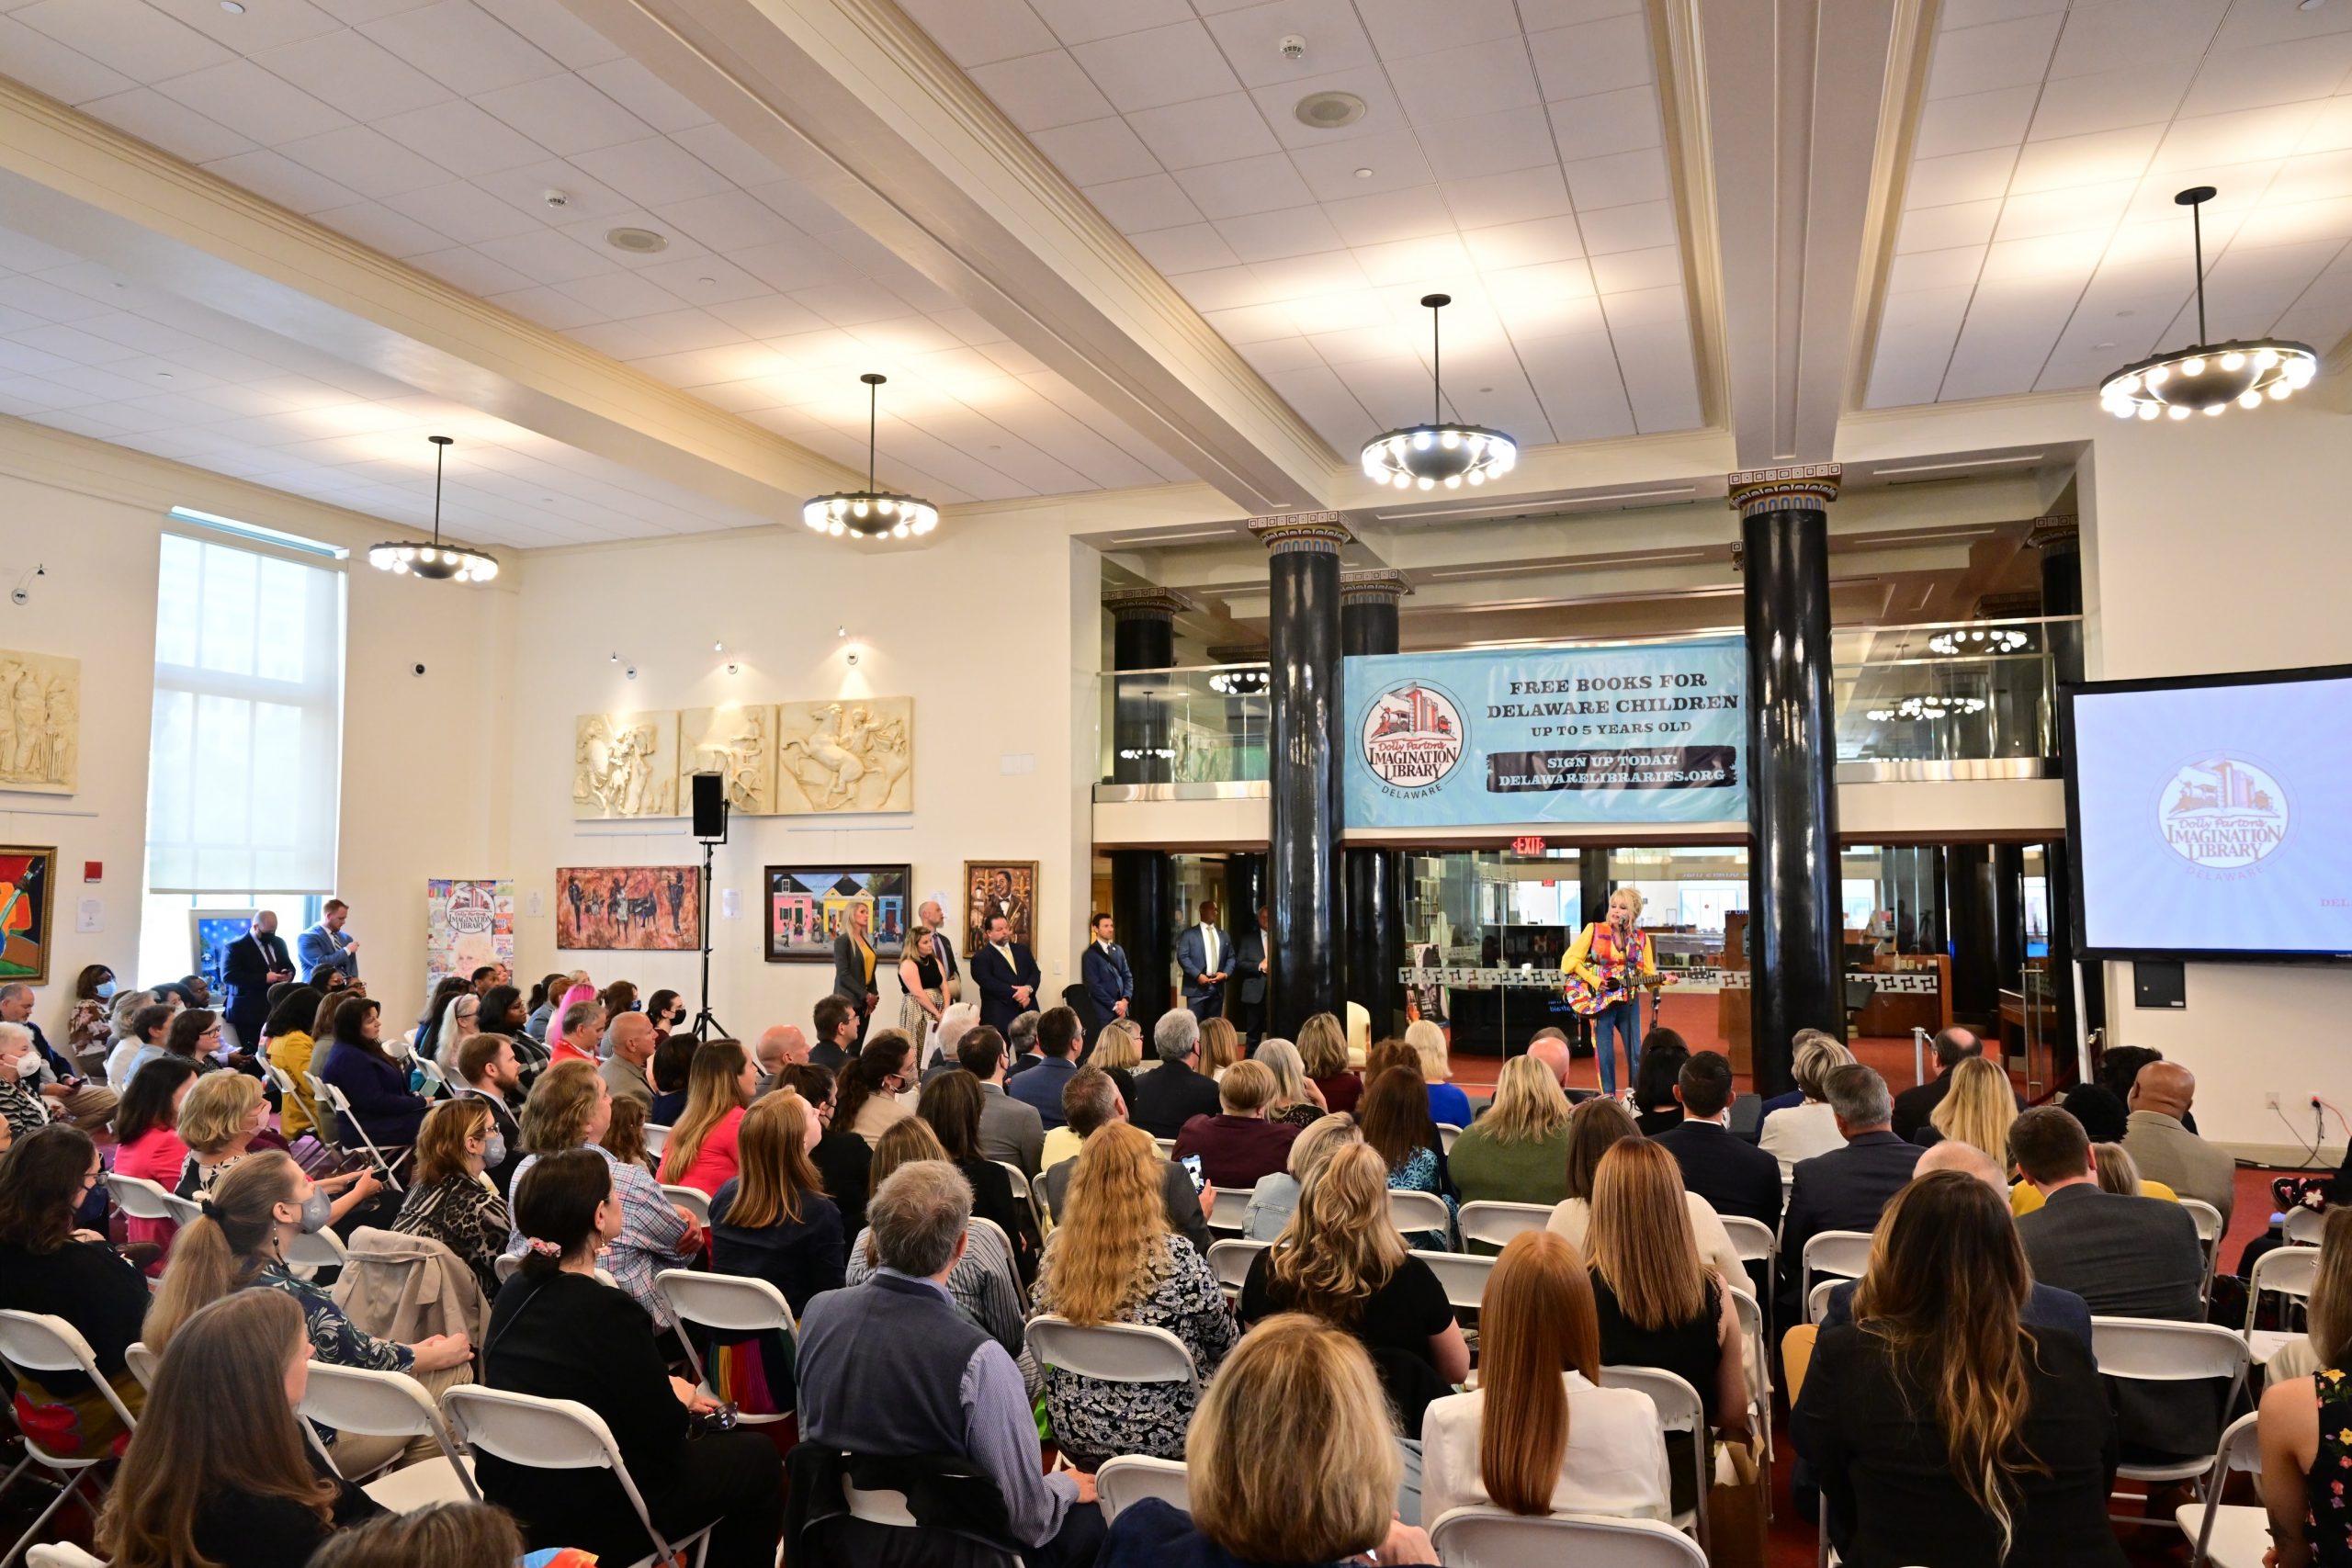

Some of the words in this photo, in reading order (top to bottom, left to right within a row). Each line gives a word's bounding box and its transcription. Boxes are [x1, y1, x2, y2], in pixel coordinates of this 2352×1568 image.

[1510, 680, 1569, 694] FREE
[1576, 676, 1652, 692] BOOKS
[1659, 673, 1707, 688] FOR
[1487, 700, 1610, 718] DELAWARE
[1616, 694, 1738, 713] CHILDREN
[1532, 727, 1553, 737] UP
[1556, 726, 1578, 736] TO
[1582, 725, 1592, 735] 5
[1597, 723, 1654, 734] YEARS
[1658, 721, 1691, 732] OLD
[1378, 740, 1404, 754] Dolly
[1369, 747, 1457, 765] IMAGINATION
[1547, 757, 1587, 768] SIGN
[1591, 756, 1614, 768] UP
[1618, 754, 1678, 766] TODAY:
[1385, 763, 1442, 781] LIBRARY
[1499, 770, 1725, 786] DELAWARELIBRARIES.ORG
[1382, 784, 1442, 799] DELAWARE
[2178, 818, 2211, 829] Dolly
[2166, 824, 2281, 844] IMAGINATION
[1517, 837, 1542, 854] EXIT
[2188, 842, 2262, 862] LIBRARY
[2186, 865, 2265, 882] DELAWARE
[2320, 898, 2352, 908] DEL
